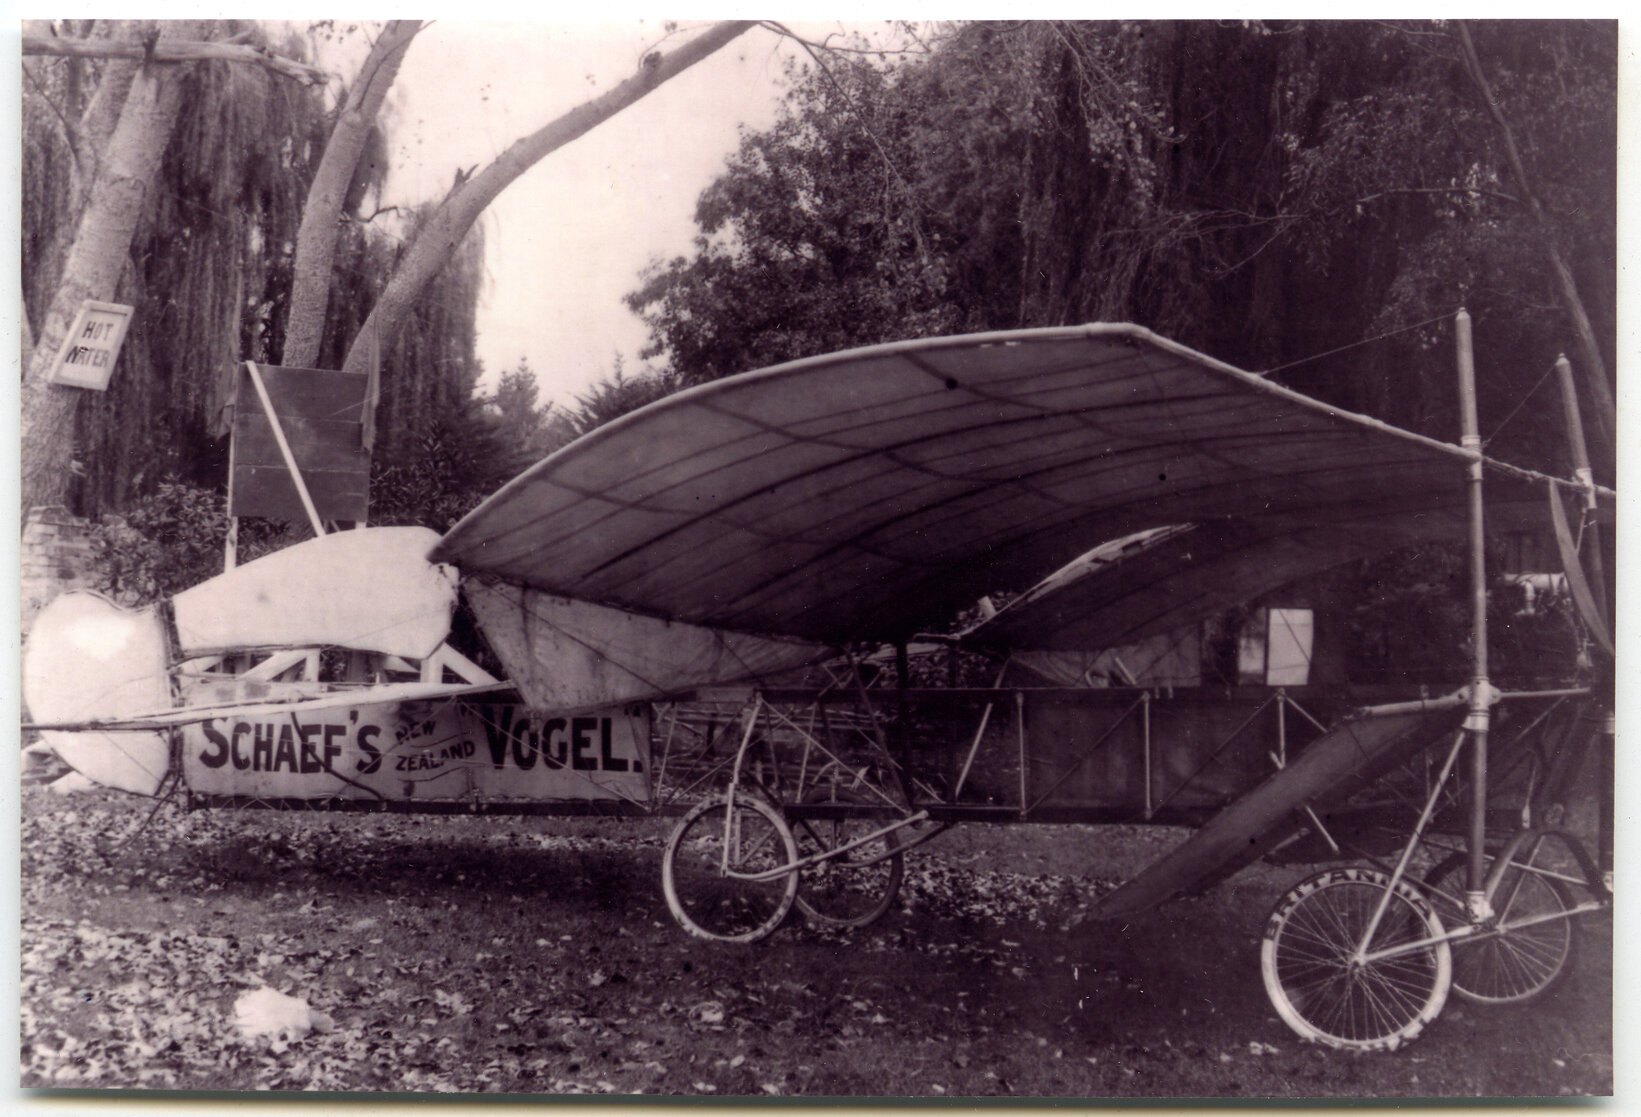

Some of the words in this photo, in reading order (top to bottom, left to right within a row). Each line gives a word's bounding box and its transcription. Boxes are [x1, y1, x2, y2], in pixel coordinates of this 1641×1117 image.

[81, 320, 115, 341] HOT
[395, 720, 436, 745] NEW
[395, 740, 476, 772] ZEALAND
